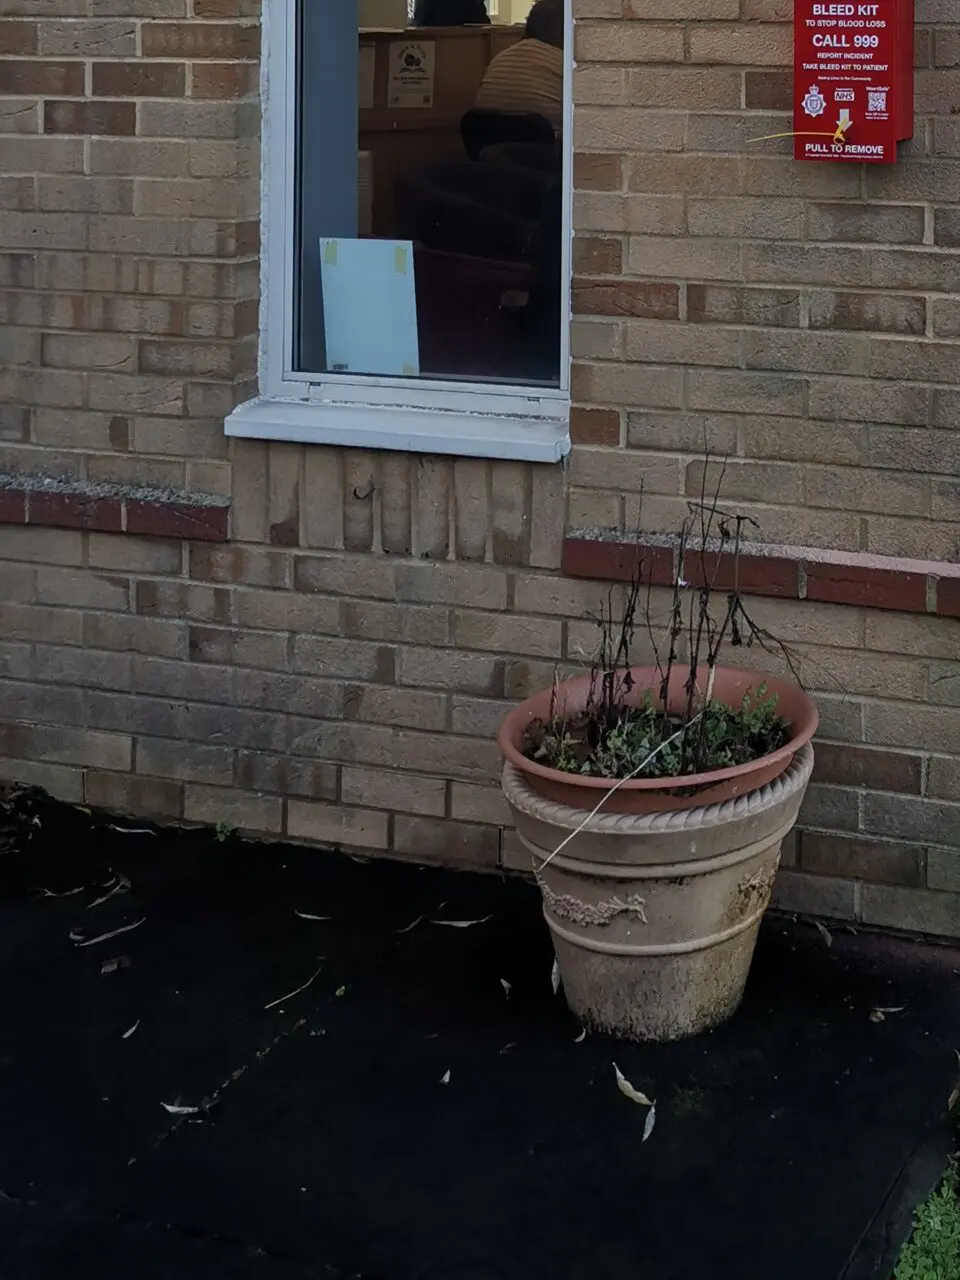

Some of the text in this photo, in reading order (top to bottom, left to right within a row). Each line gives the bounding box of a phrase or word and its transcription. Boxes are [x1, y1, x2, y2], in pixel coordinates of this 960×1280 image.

[813, 4, 879, 16] BLEED KIT
[866, 20, 886, 28] LOSS
[812, 34, 879, 48] CALL 999
[835, 92, 853, 100] NHS
[805, 144, 884, 154] PULL TO REMOVE
